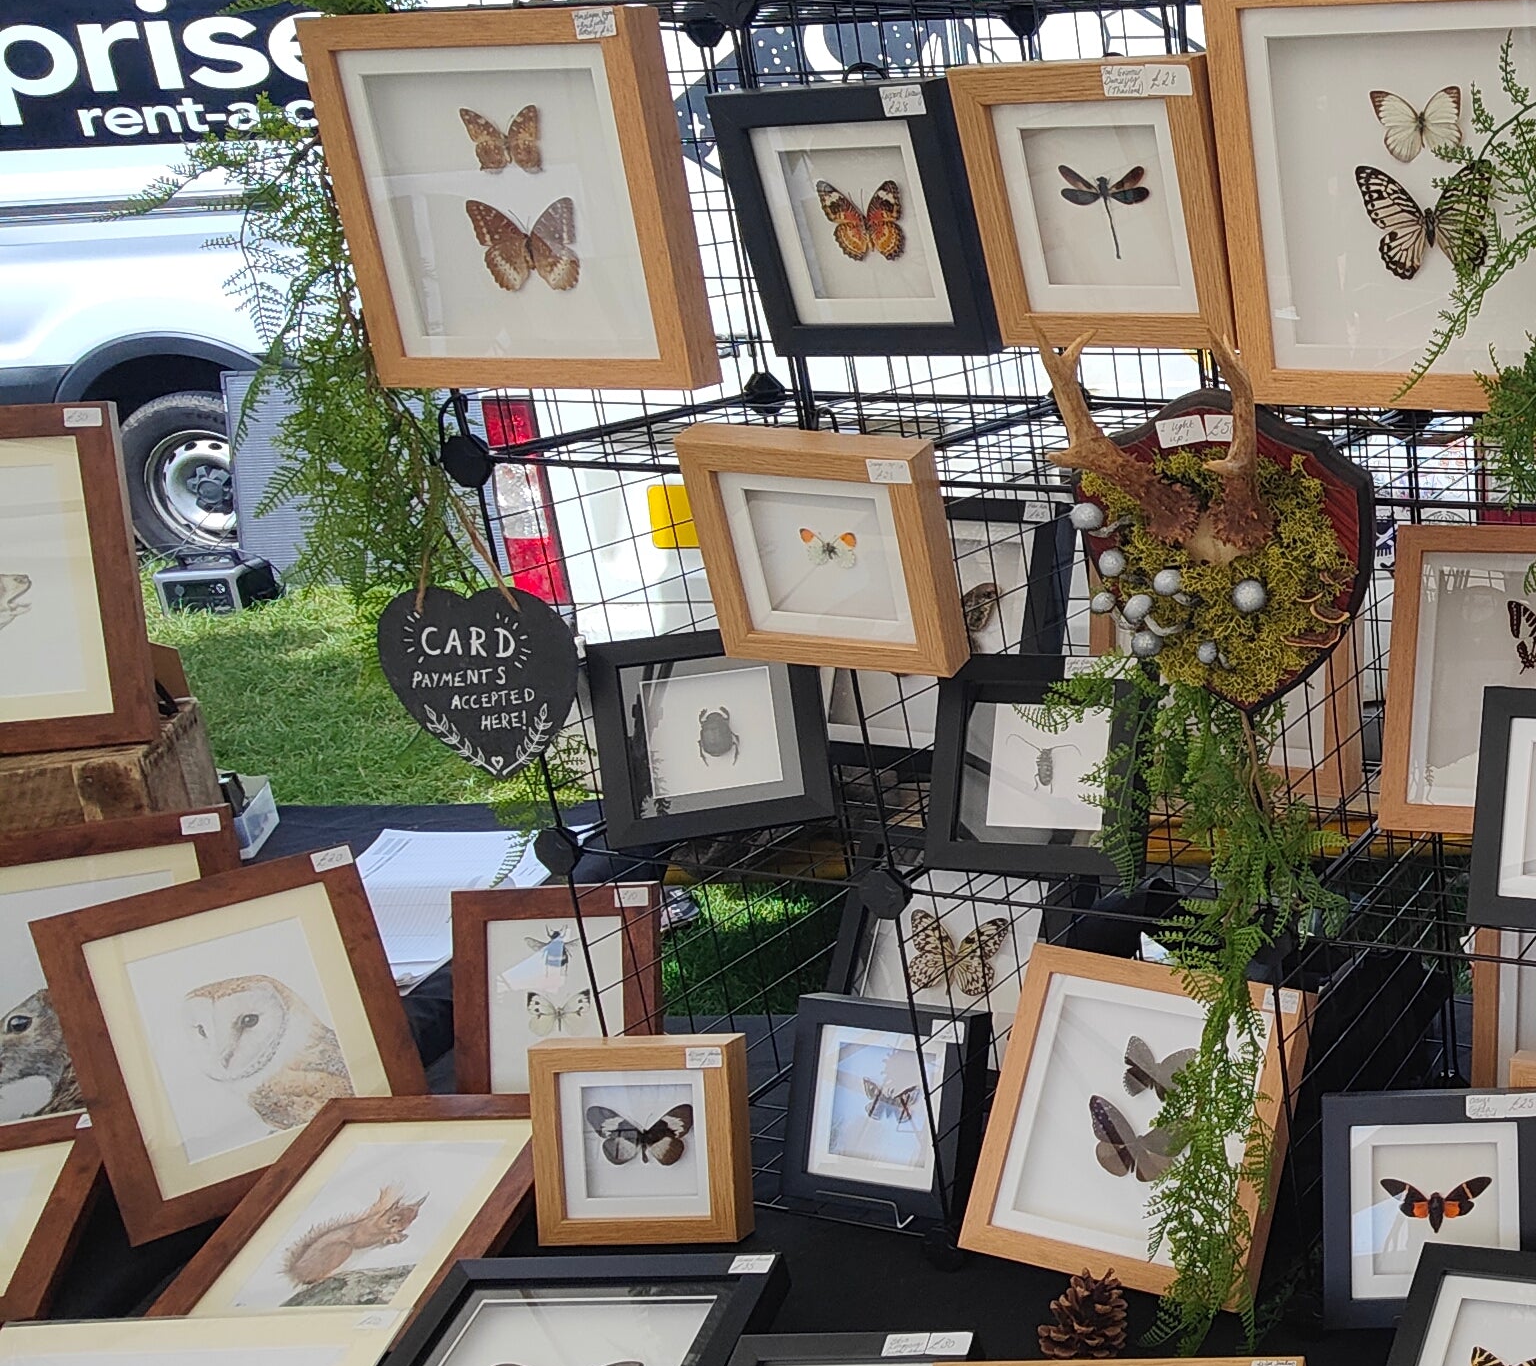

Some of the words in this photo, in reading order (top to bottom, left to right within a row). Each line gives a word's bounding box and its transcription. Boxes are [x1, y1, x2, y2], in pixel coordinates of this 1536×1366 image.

[1150, 69, 1177, 89] £28
[77, 97, 318, 138] rent-a-c
[421, 626, 517, 658] CARD
[411, 666, 507, 689] PAYMENTS
[450, 687, 536, 711] ACCEPTED
[480, 713, 528, 731] HERE!
[1508, 1096, 1535, 1111] £25
